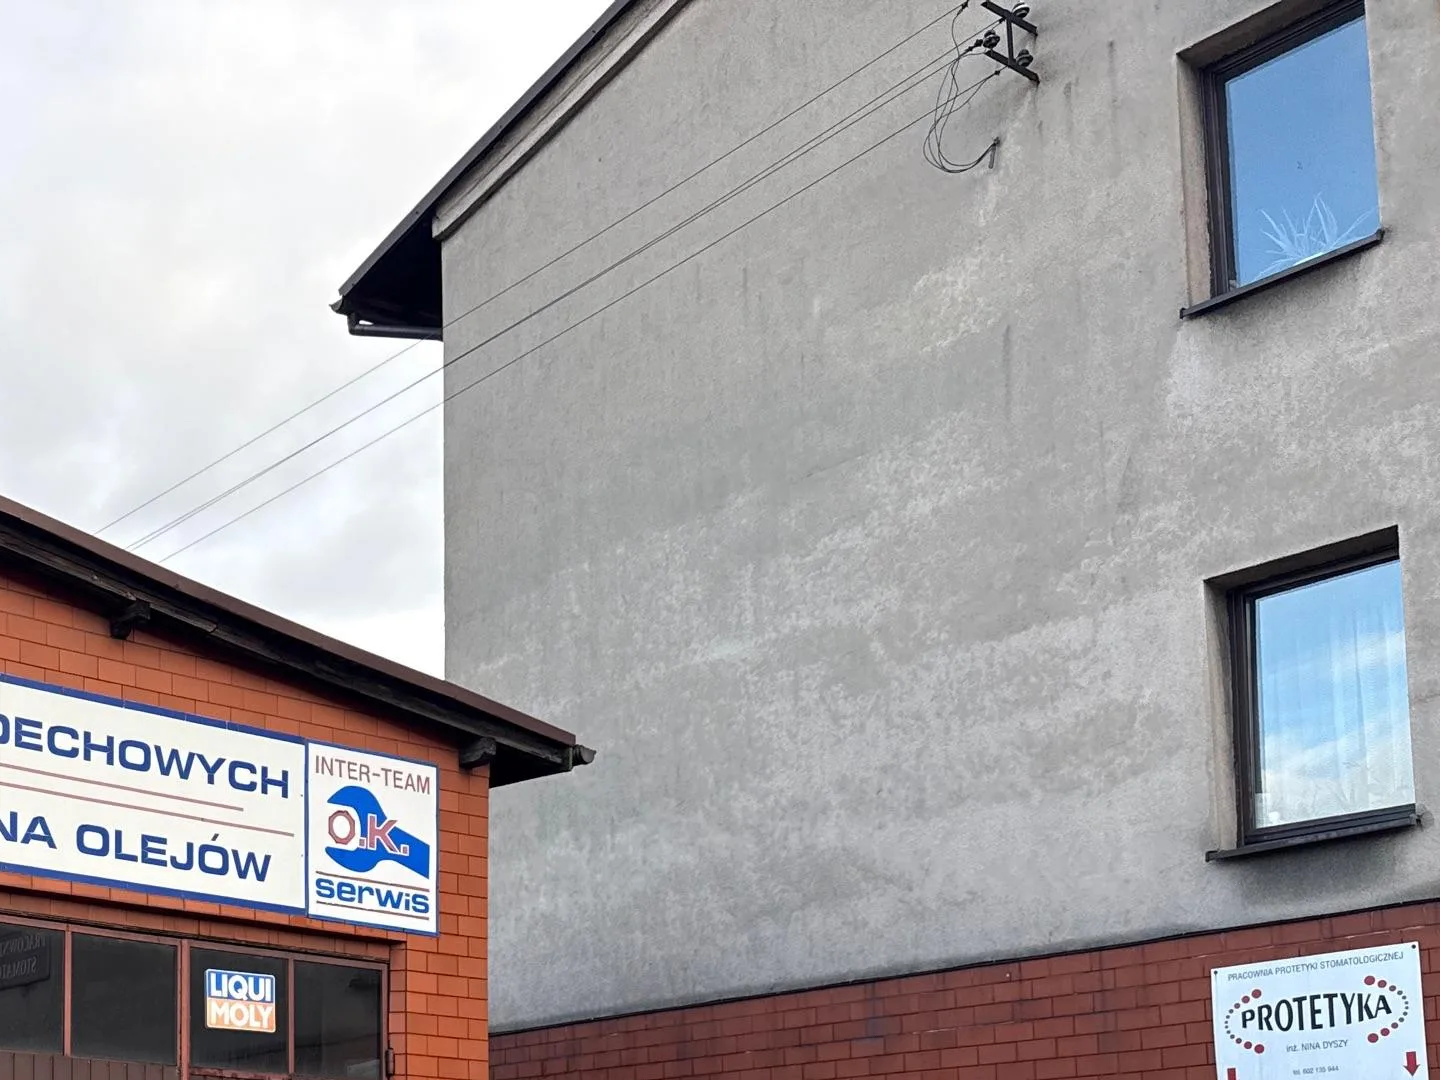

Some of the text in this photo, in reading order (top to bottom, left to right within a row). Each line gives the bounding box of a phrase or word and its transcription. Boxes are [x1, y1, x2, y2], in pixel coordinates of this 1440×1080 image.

[315, 755, 431, 796] INTER-TEAM
[76, 823, 272, 883] OLEJÓW
[1228, 951, 1404, 981] PRACOWNIA PROTETYKI STOMATOLOGICZNEJ
[210, 973, 272, 1002] LIQUI
[210, 1001, 273, 1029] MOLY
[1241, 993, 1392, 1031] PROTETYKA
[1302, 1042, 1320, 1051] NINA
